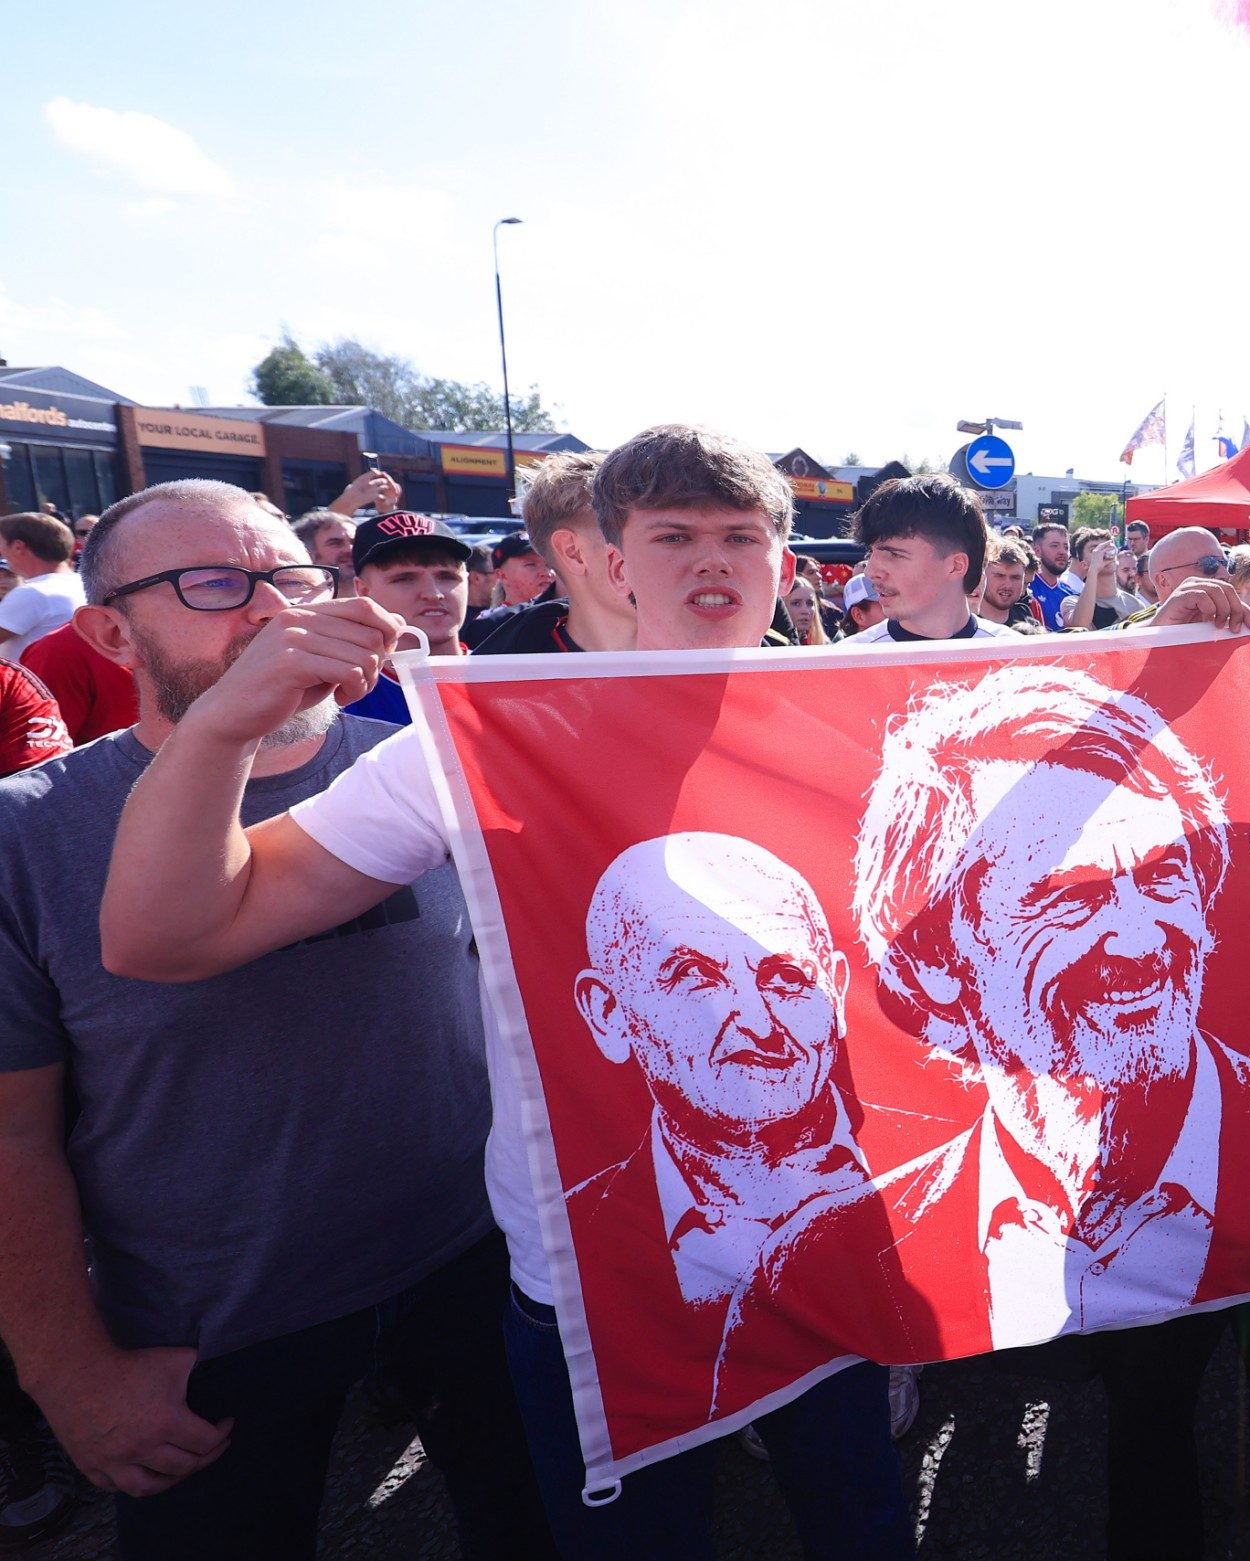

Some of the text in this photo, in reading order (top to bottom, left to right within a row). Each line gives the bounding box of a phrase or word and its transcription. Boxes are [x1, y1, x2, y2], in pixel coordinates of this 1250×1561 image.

[138, 423, 172, 436] YOUR
[175, 426, 212, 440] LOCAL
[450, 456, 497, 466] ALIGNMENT
